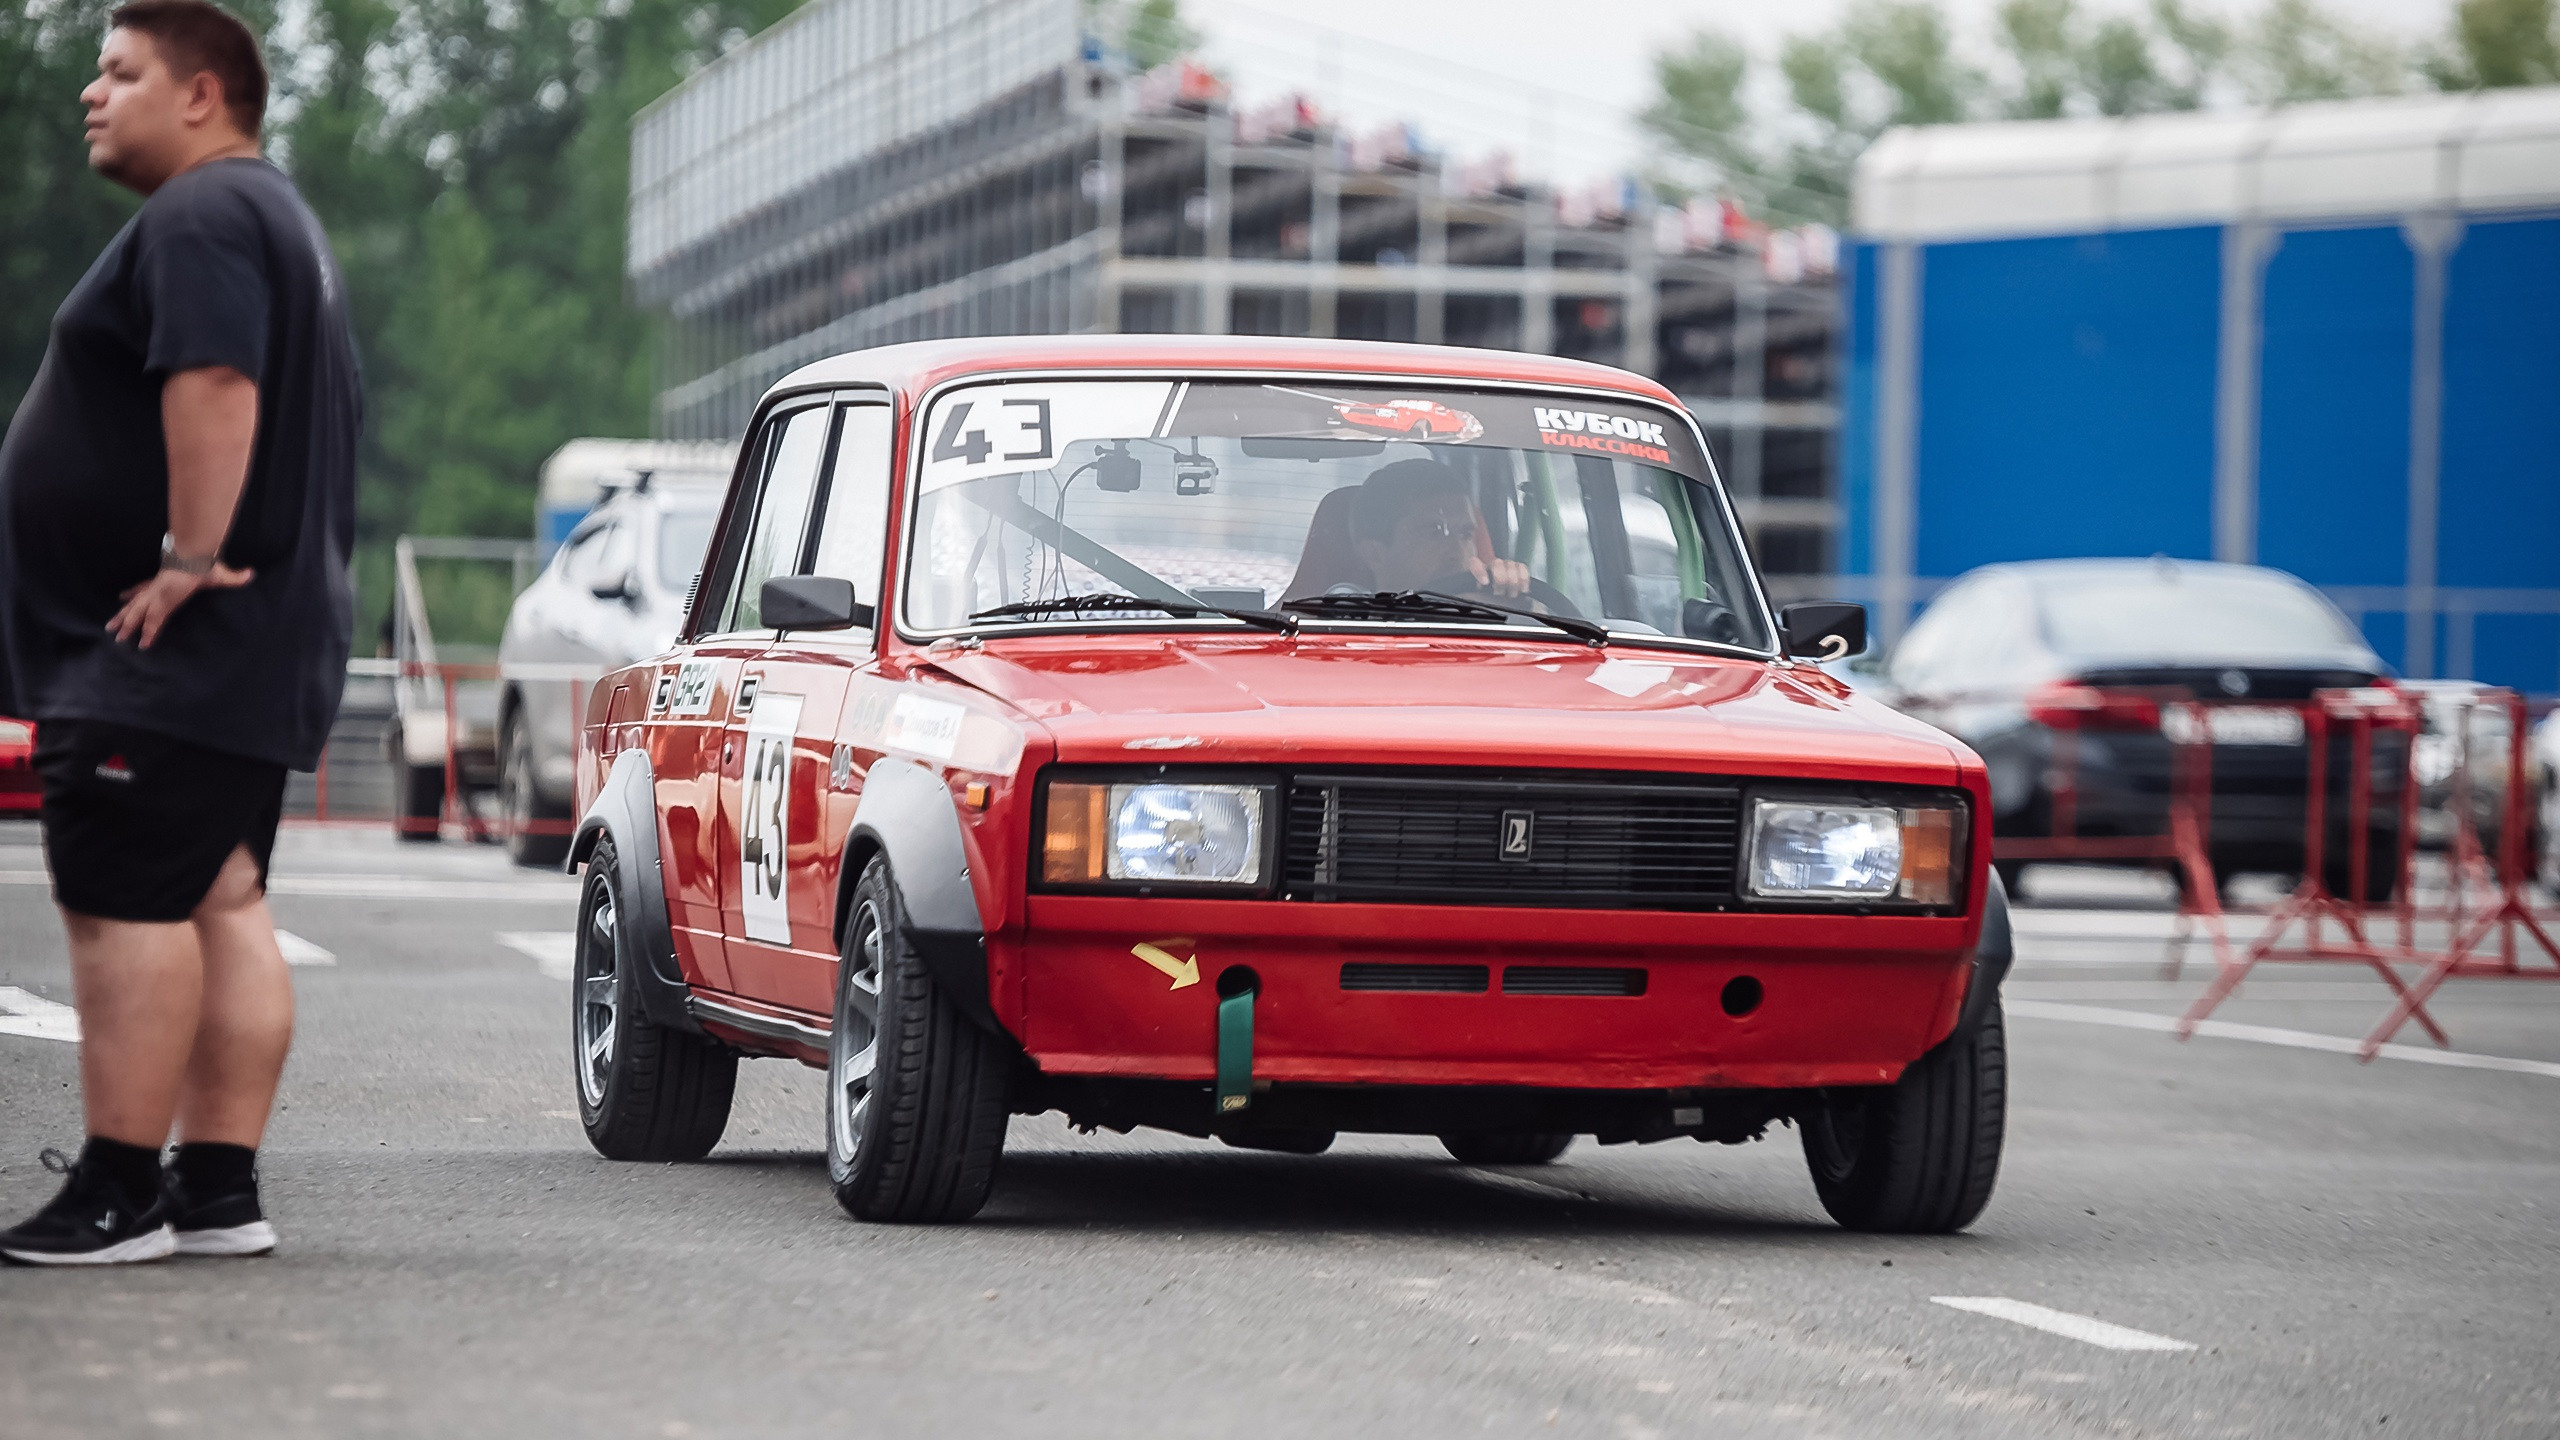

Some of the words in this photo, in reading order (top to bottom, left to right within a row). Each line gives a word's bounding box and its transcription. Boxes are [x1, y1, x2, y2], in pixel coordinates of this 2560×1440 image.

[931, 399, 1053, 465] 43
[1533, 407, 1668, 447] КУБОК
[1541, 431, 1671, 464] КЛАССИКИ
[743, 738, 785, 901] 43
